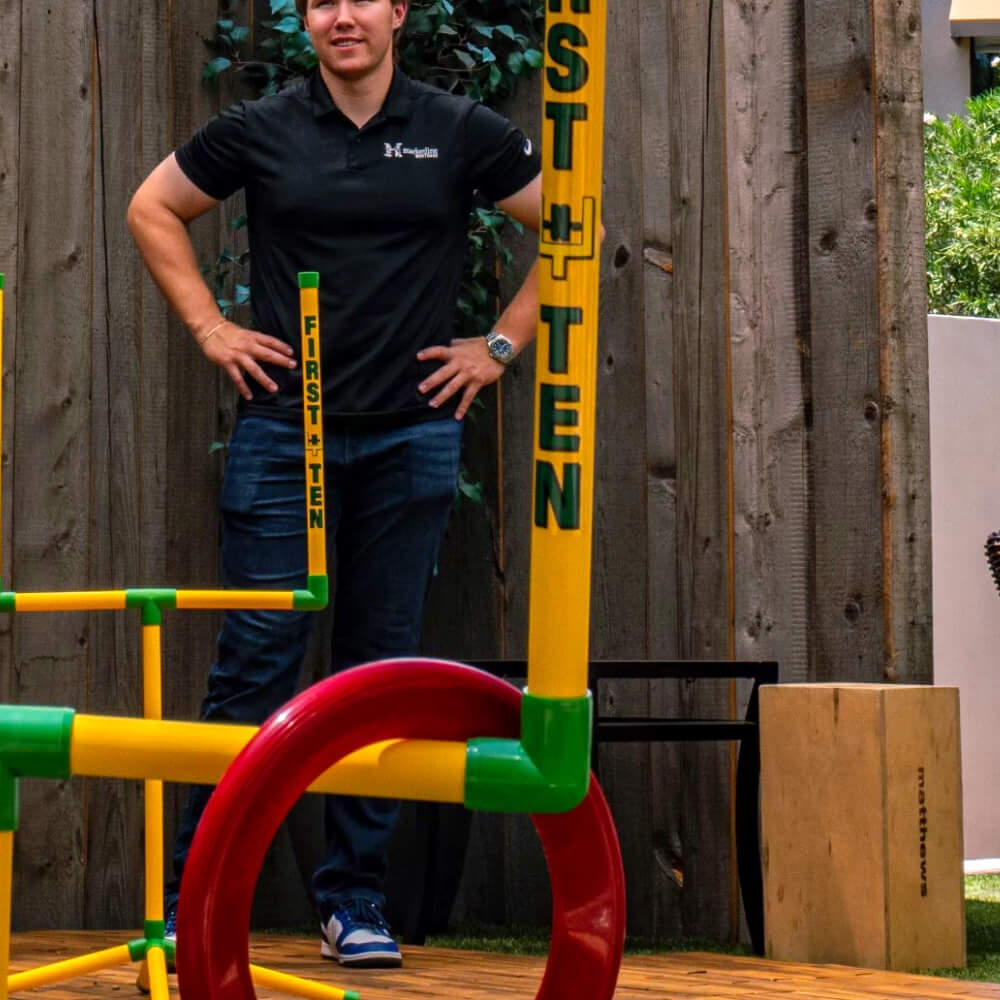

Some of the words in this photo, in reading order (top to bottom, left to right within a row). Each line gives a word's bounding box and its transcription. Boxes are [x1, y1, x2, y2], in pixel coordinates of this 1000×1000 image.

[304, 316, 320, 425] FIRST
[534, 304, 583, 530] TEN
[309, 463, 323, 529] TEN
